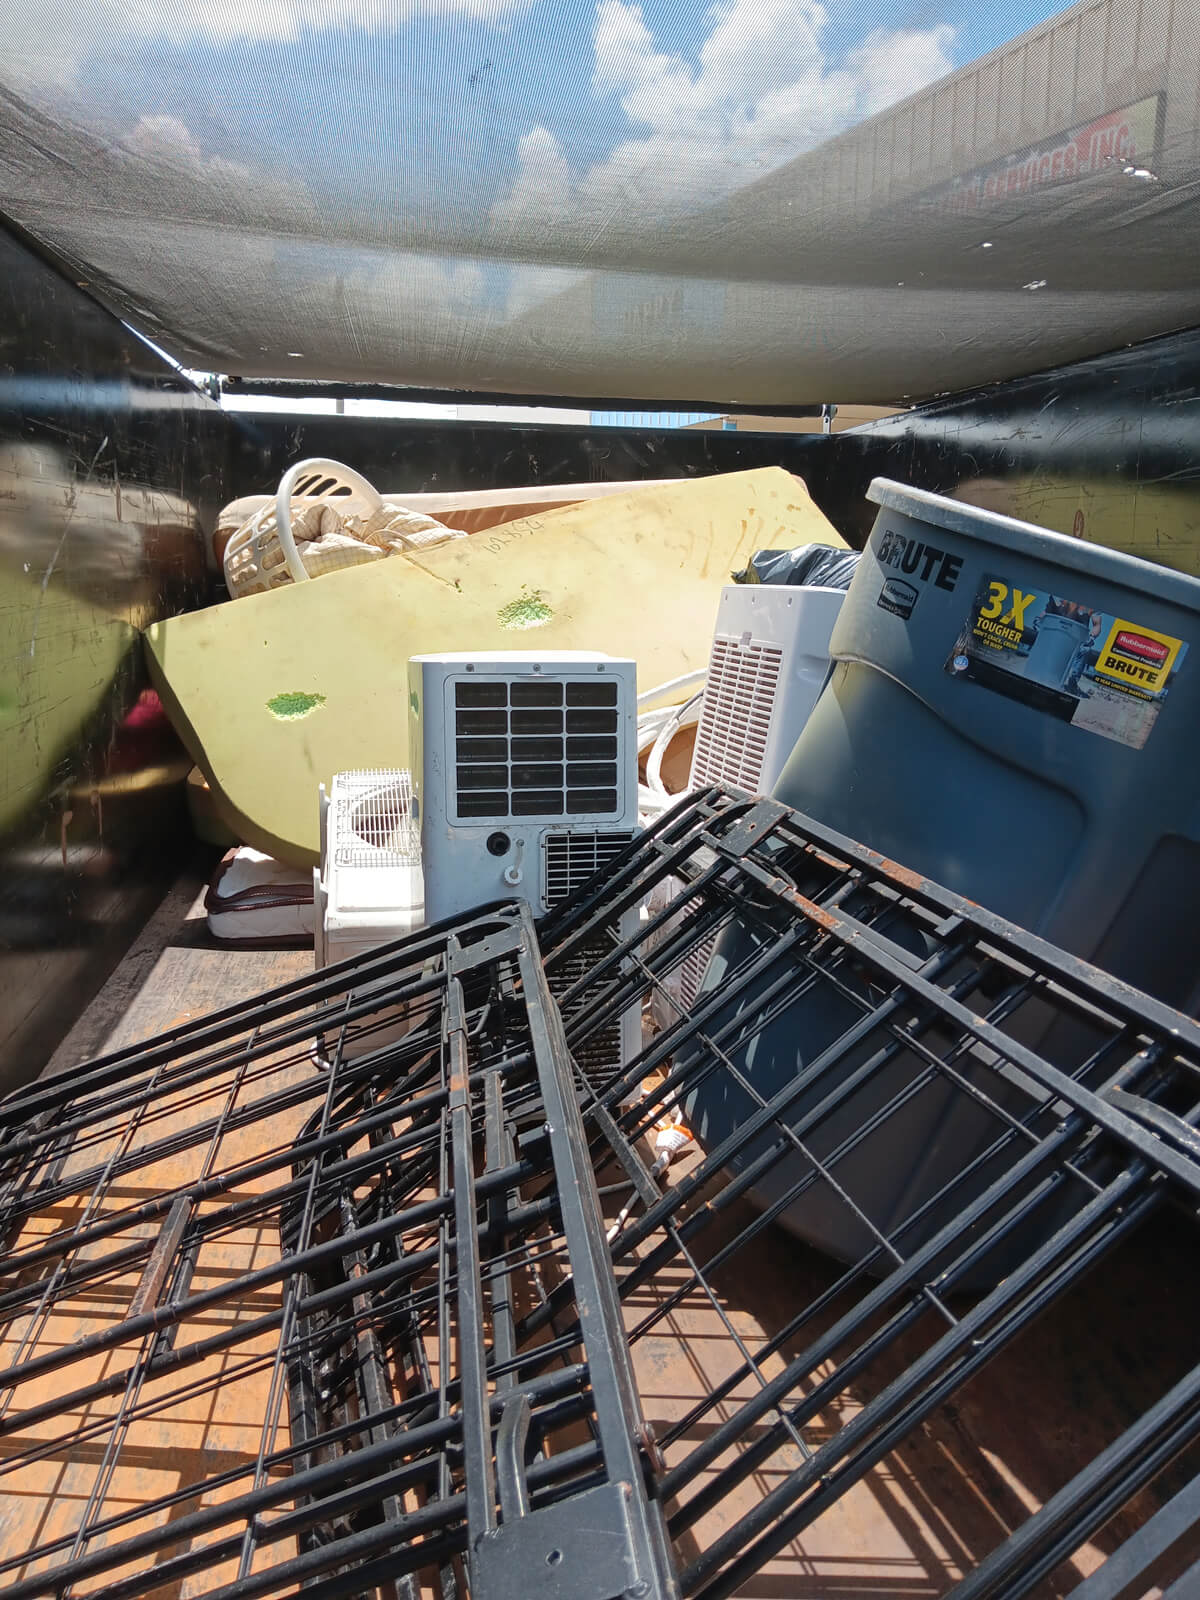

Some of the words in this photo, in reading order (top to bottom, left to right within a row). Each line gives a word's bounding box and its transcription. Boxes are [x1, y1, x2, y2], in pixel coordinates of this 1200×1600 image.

[983, 142, 1080, 201] SERVICES
[877, 530, 965, 592] BRUTE
[980, 582, 1037, 631] 3X
[976, 616, 1023, 643] TOUGHER
[1120, 635, 1166, 656] Rubbermaid
[1104, 656, 1159, 684] BRUTE
